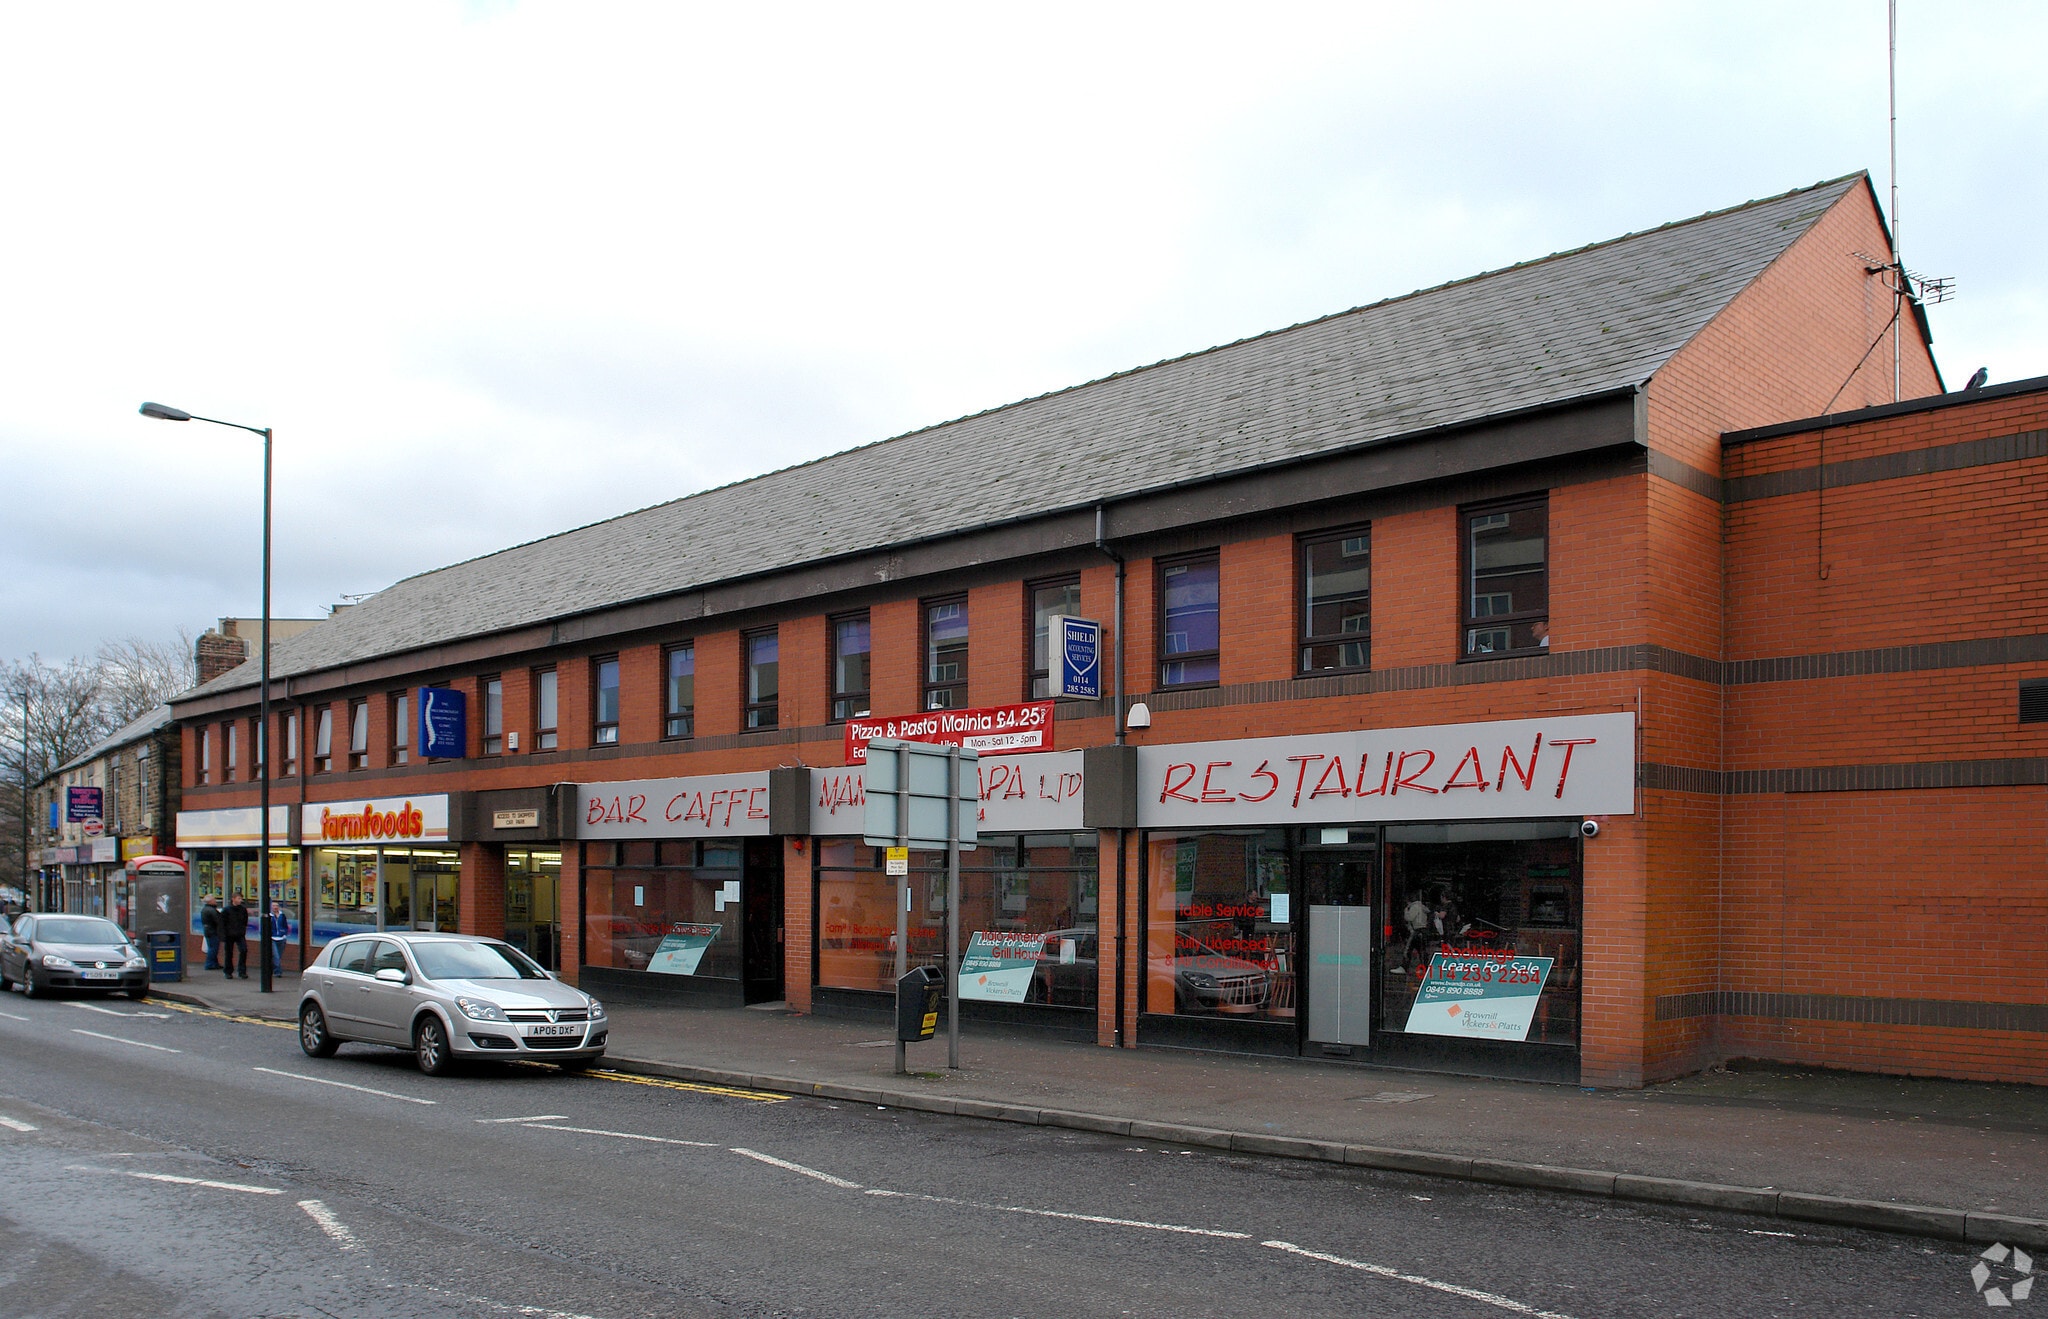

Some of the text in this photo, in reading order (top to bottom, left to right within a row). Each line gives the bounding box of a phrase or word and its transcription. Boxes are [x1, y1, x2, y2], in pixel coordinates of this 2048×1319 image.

[1067, 630, 1095, 643] SHIELD
[1068, 644, 1095, 654] ACCOUNTING
[1071, 653, 1092, 663] SERVICES
[1073, 675, 1089, 684] 0114
[1067, 684, 1096, 695] 285 2585
[851, 706, 1040, 740] Pizza & Pasta Mainia £4.25
[971, 738, 986, 748] Mon
[992, 736, 1003, 746] Sat
[1006, 736, 1014, 745] 12
[1020, 735, 1037, 745] 5pm
[1159, 732, 1597, 808] RESTAURANT
[587, 788, 769, 828] BAR CAFFE
[321, 800, 423, 840] farmfoods
[1180, 904, 1213, 916] Table
[1216, 904, 1265, 917] Service
[1176, 935, 1267, 952] Fully Licenced
[992, 946, 1047, 961] Grill House
[1441, 943, 1515, 964] Bookings
[1165, 954, 1279, 970] & Air Conditioned
[1441, 960, 1540, 974] Lease For Sale
[1415, 964, 1540, 984] 0114 233 2254
[1425, 985, 1484, 996] 0845 890 8888
[1464, 1011, 1498, 1020] Brownill
[533, 1026, 575, 1035] AP06 DXF
